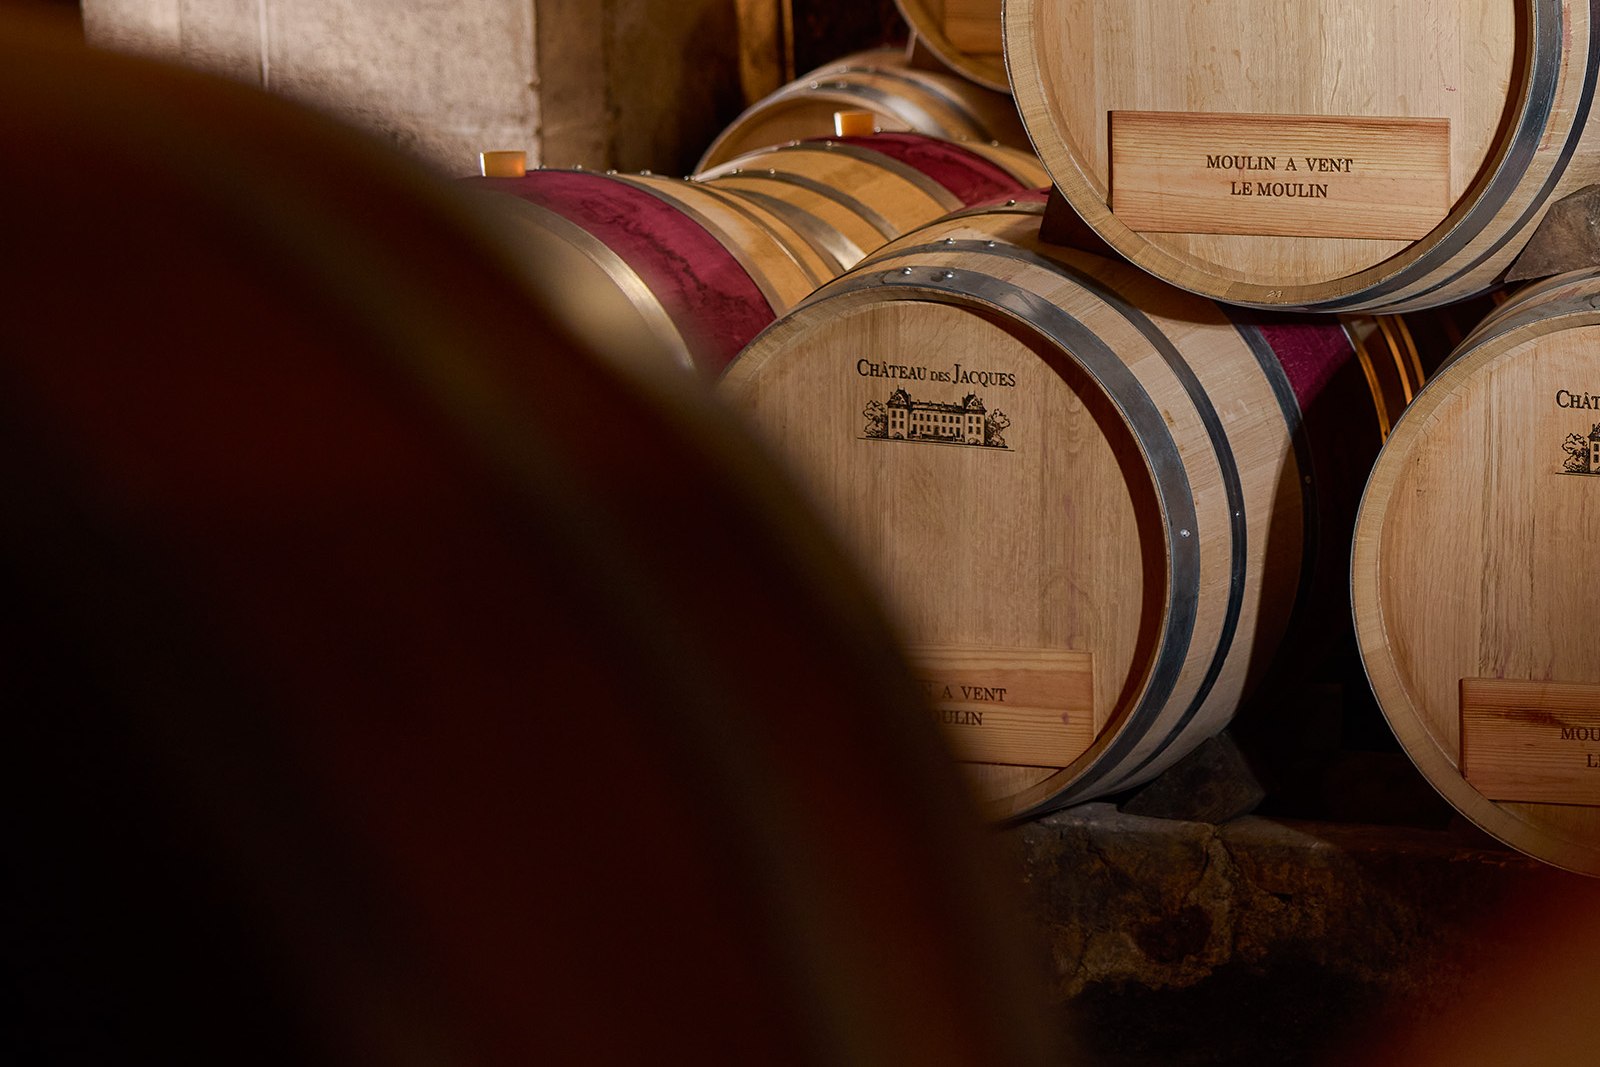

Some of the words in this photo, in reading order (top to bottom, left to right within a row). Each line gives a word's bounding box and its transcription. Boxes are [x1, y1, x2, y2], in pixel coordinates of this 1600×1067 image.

[1205, 154, 1276, 171] MOULIN
[1284, 156, 1298, 172] A
[1304, 157, 1354, 173] VENT
[1230, 181, 1253, 196] LE
[1256, 181, 1328, 198] MOULIN
[930, 370, 951, 383] DES
[952, 363, 1017, 388] JACQUES
[942, 685, 953, 700] A
[960, 685, 1007, 702] VENT
